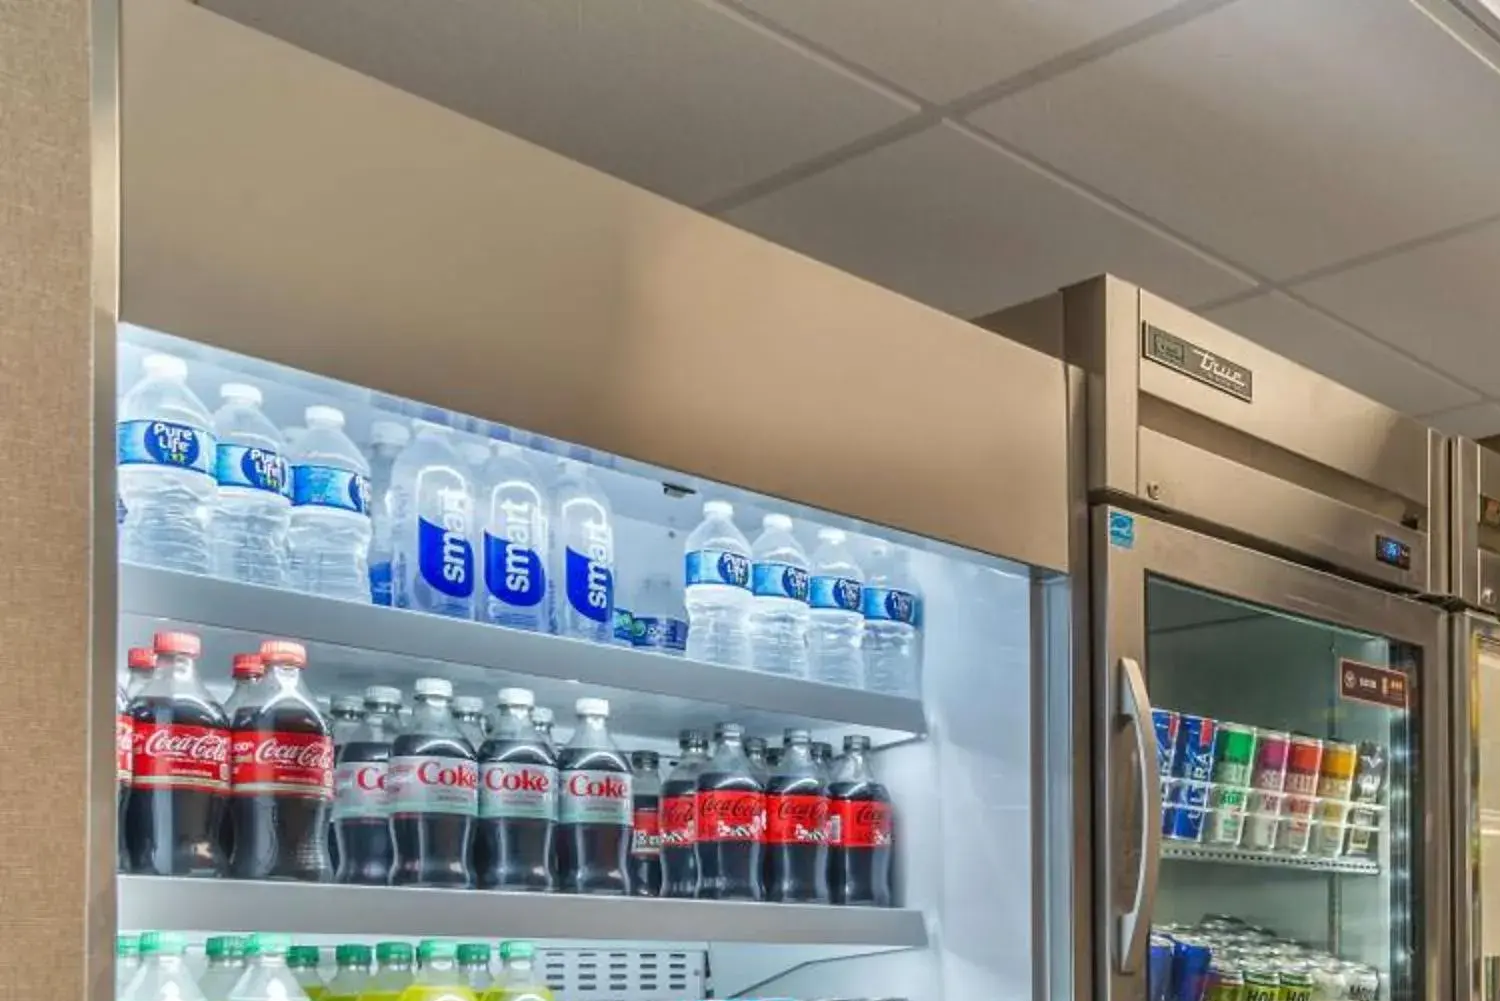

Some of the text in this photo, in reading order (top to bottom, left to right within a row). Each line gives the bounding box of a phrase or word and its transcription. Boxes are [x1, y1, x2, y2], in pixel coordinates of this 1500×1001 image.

[153, 422, 193, 440] Pure
[159, 436, 190, 453] Life
[501, 499, 530, 594] smart
[583, 517, 609, 609] smart
[146, 728, 229, 763] Coca-Cola
[416, 761, 477, 790] Coke
[485, 768, 550, 793] Coke
[569, 773, 628, 800] Coke
